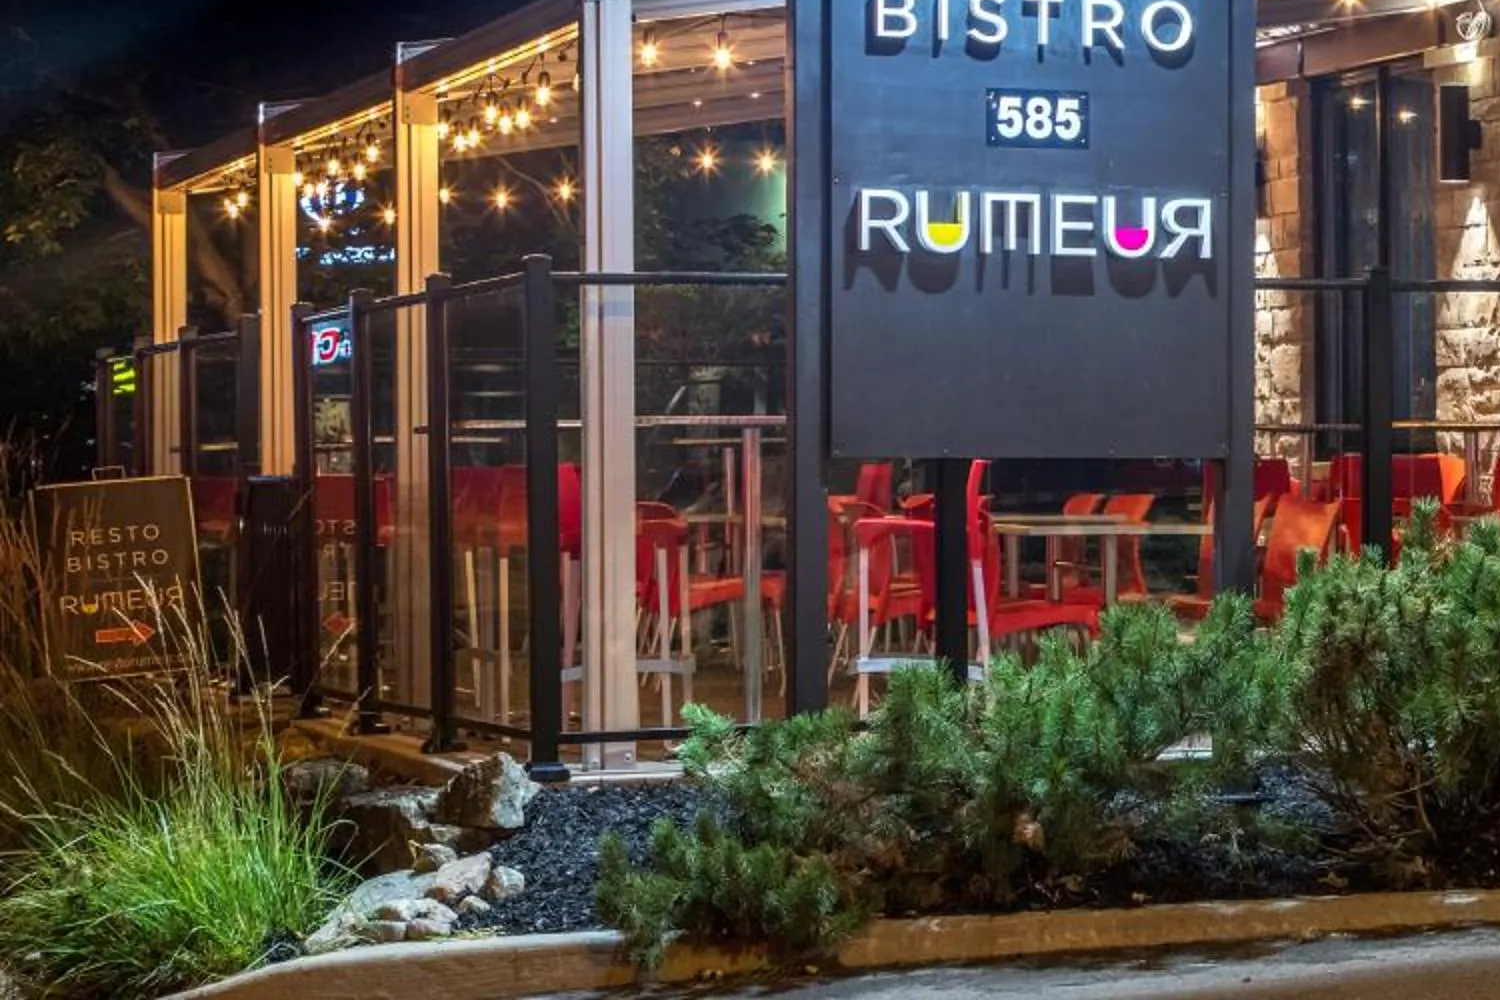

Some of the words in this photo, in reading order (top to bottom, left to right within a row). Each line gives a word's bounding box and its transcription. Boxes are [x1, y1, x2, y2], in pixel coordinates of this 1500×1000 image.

[996, 96, 1082, 140] 585
[856, 187, 1213, 260] RUMEUR
[70, 524, 160, 547] RESTO
[66, 549, 169, 573] BISTRO
